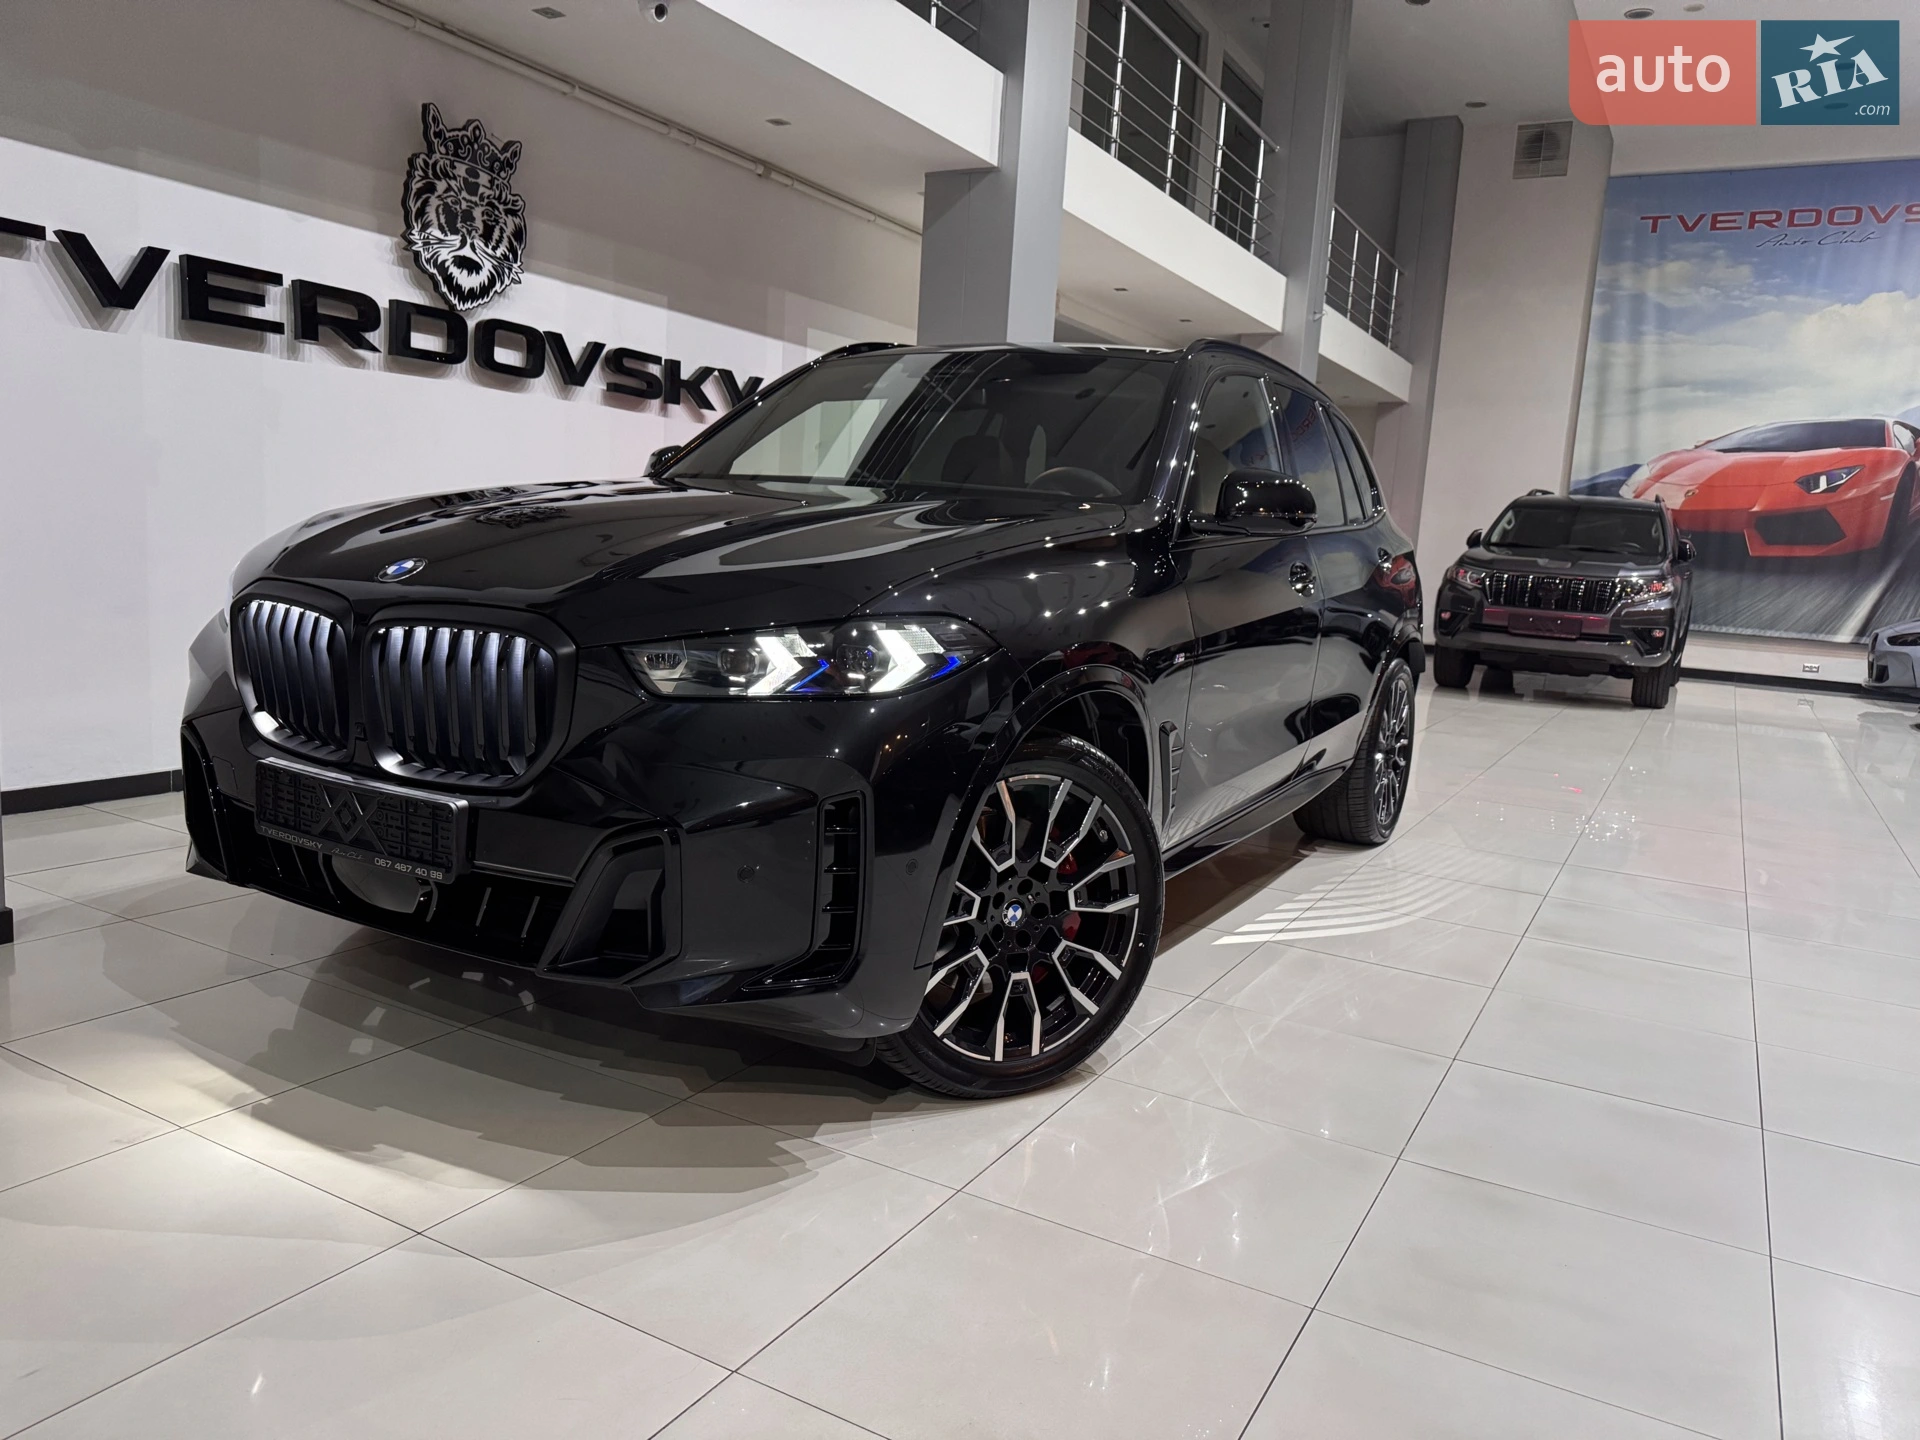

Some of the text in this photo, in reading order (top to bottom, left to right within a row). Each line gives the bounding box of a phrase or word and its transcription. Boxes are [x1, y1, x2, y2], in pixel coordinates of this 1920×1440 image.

[1756, 230, 1882, 248] Auto Club
[260, 825, 323, 850] TVERDOVSKY
[374, 857, 392, 868] 067
[394, 862, 412, 873] 487
[415, 867, 428, 877] 40
